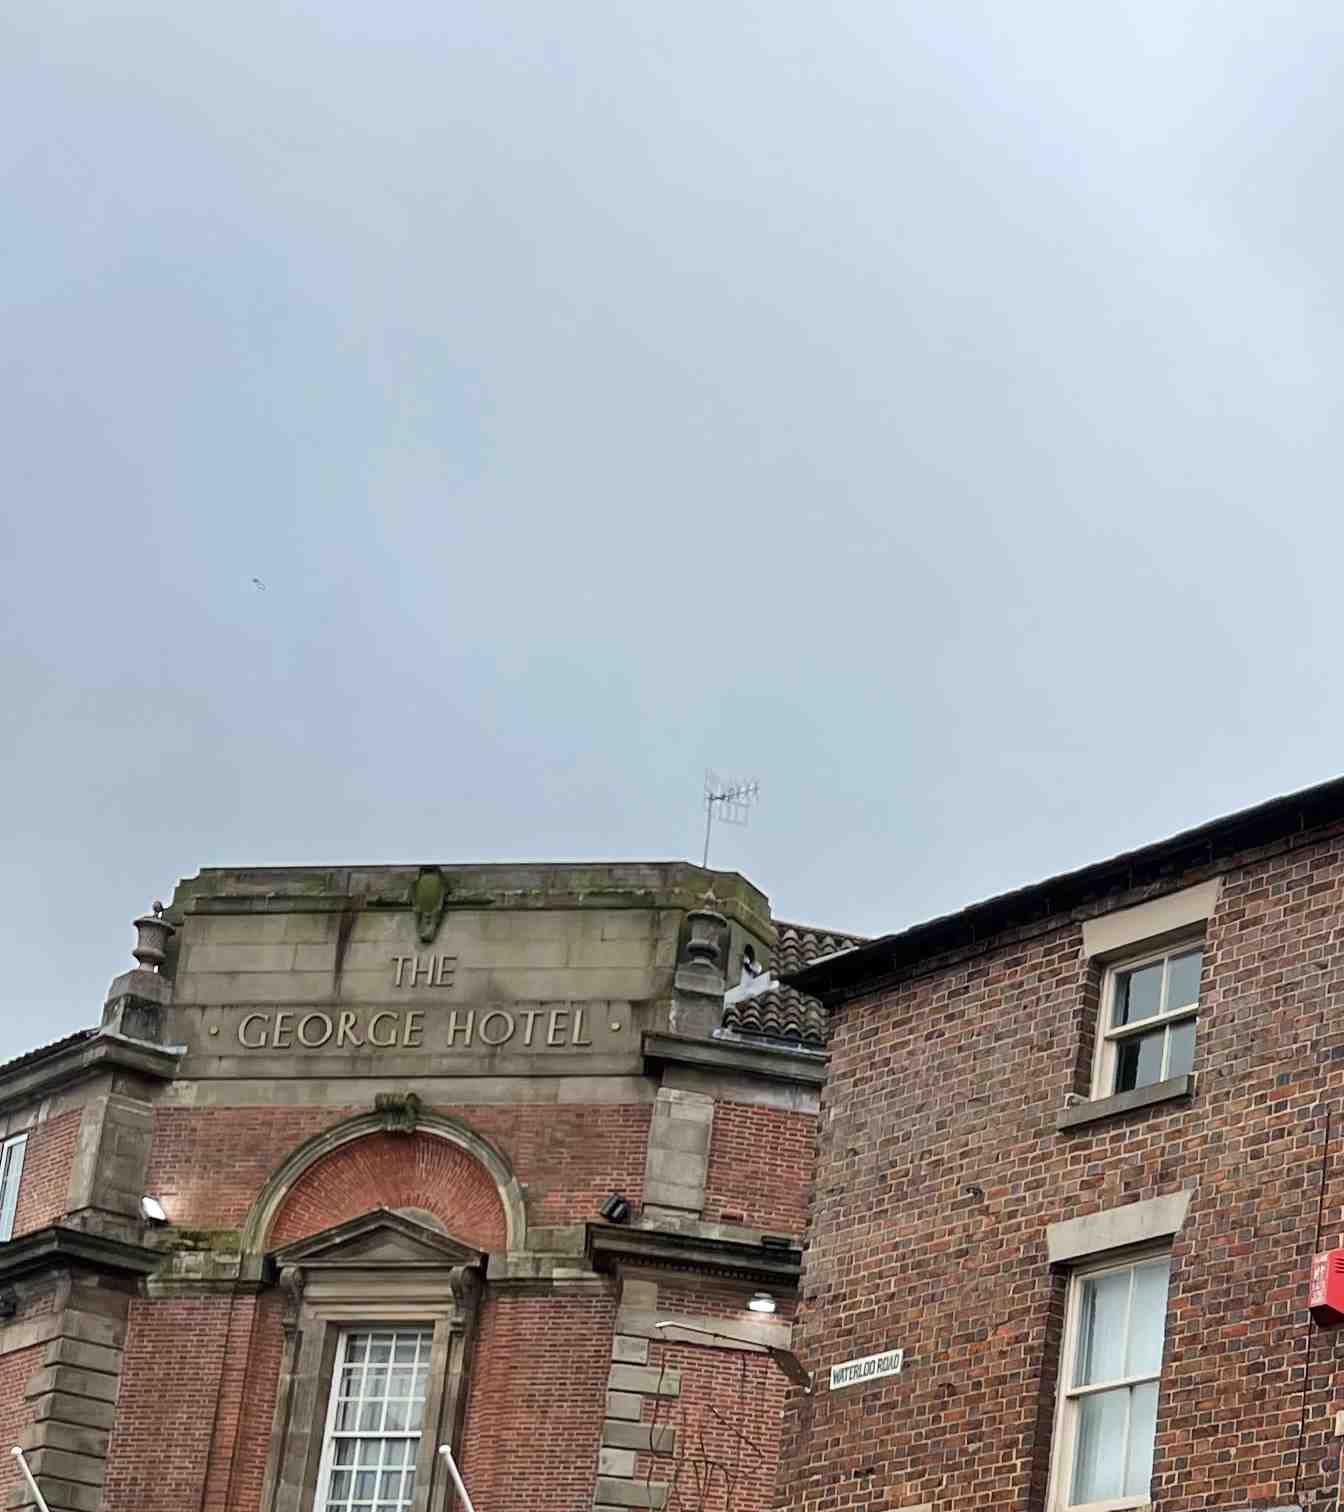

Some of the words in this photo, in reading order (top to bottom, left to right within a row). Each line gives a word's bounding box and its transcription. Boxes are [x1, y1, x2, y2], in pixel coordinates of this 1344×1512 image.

[392, 954, 457, 988] THE
[237, 1009, 425, 1049] GEORGE
[446, 1007, 593, 1047] HOTEL
[832, 1359, 876, 1385] WATERLOO
[877, 1353, 901, 1374] ROAD
